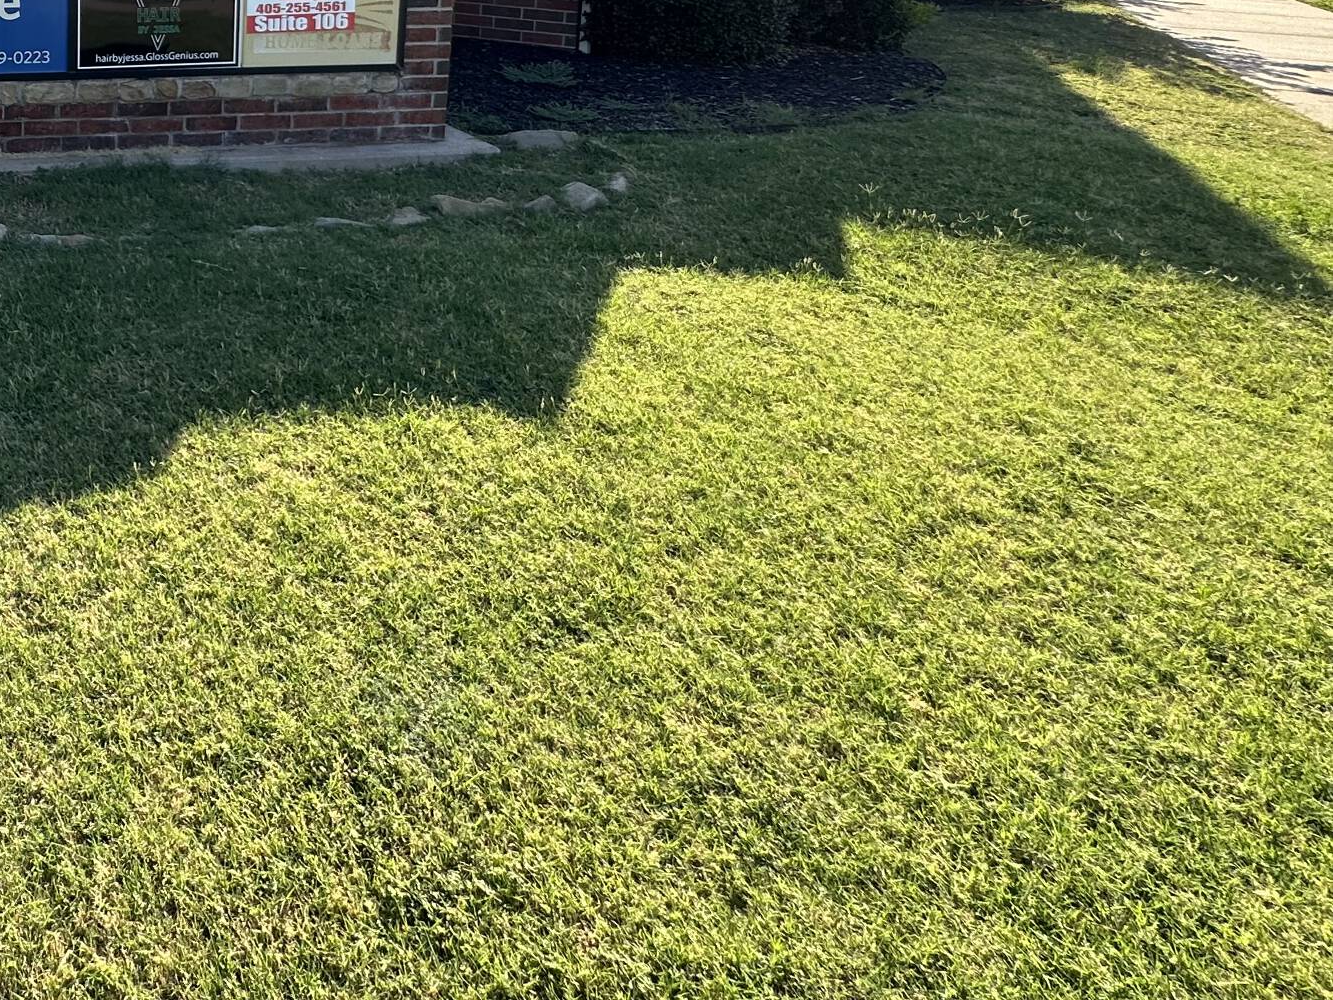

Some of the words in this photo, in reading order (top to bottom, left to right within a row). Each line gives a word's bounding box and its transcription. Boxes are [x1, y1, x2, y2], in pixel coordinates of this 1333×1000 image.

[136, 6, 181, 23] HAIR
[256, 1, 347, 14] 405-255-4561
[254, 14, 308, 32] Suite
[313, 13, 349, 30] 106
[95, 51, 219, 65] hairbyjessa.GlossGenius.com
